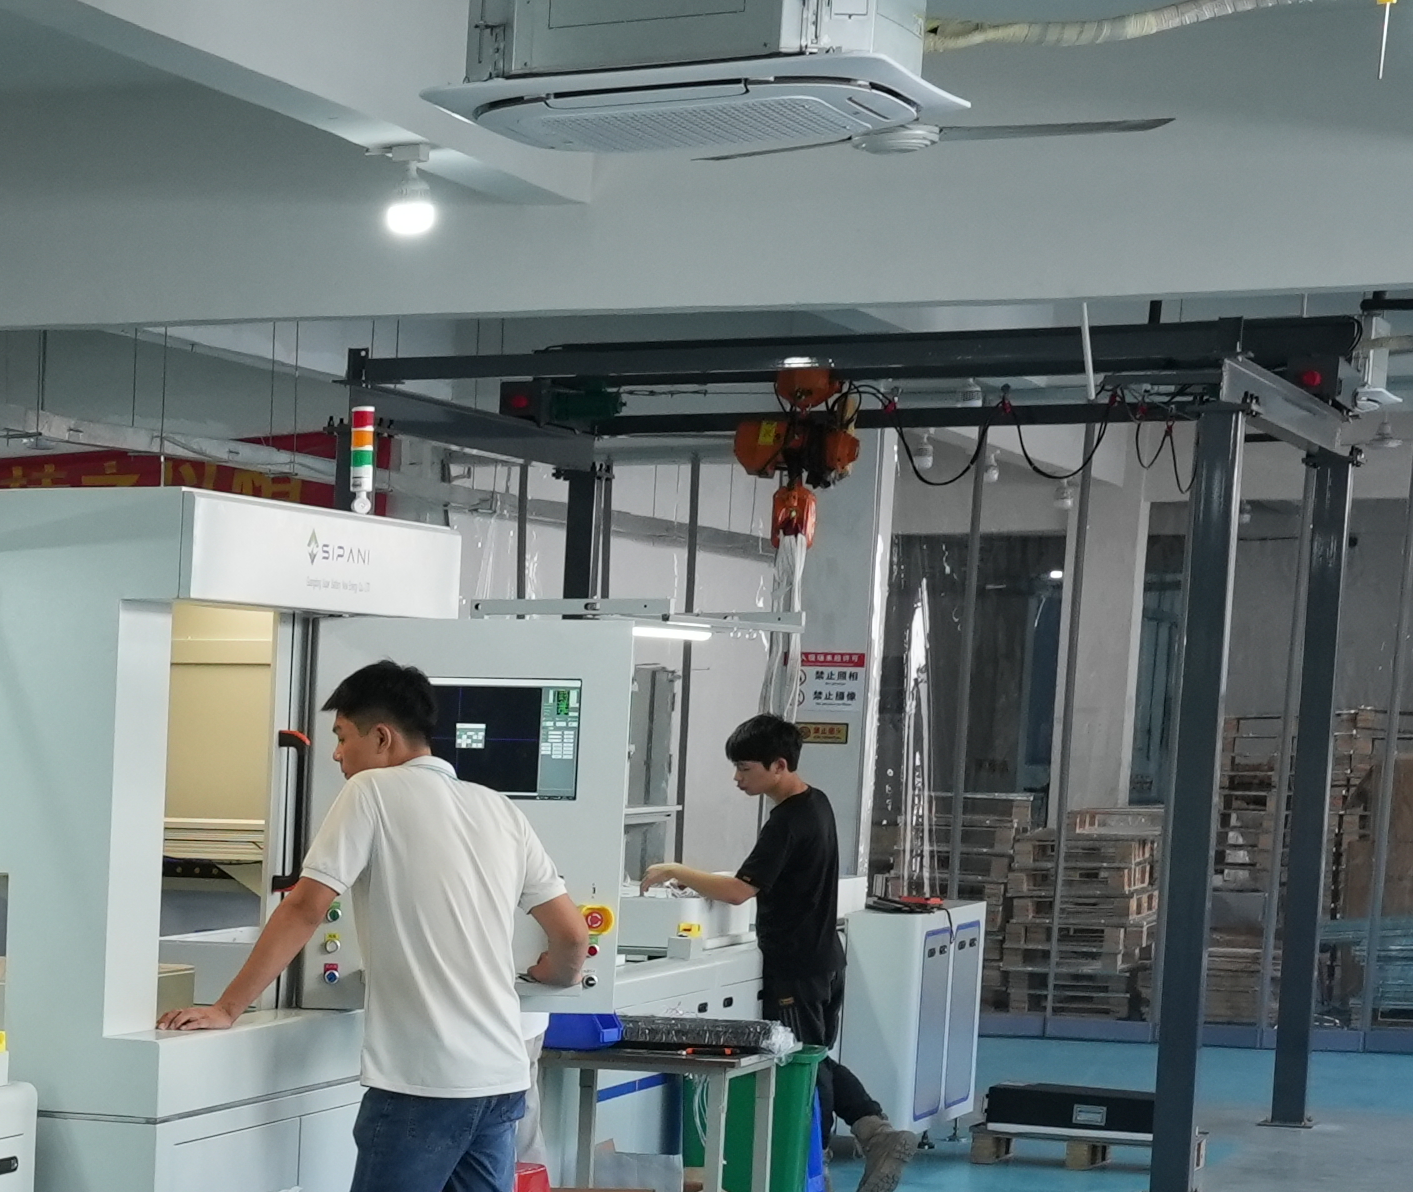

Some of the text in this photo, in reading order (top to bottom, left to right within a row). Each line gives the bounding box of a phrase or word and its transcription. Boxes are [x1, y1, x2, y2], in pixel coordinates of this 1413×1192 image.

[321, 543, 371, 566] SIPANI
[815, 670, 858, 681] 禁止照相
[813, 690, 857, 702] 禁止摄像
